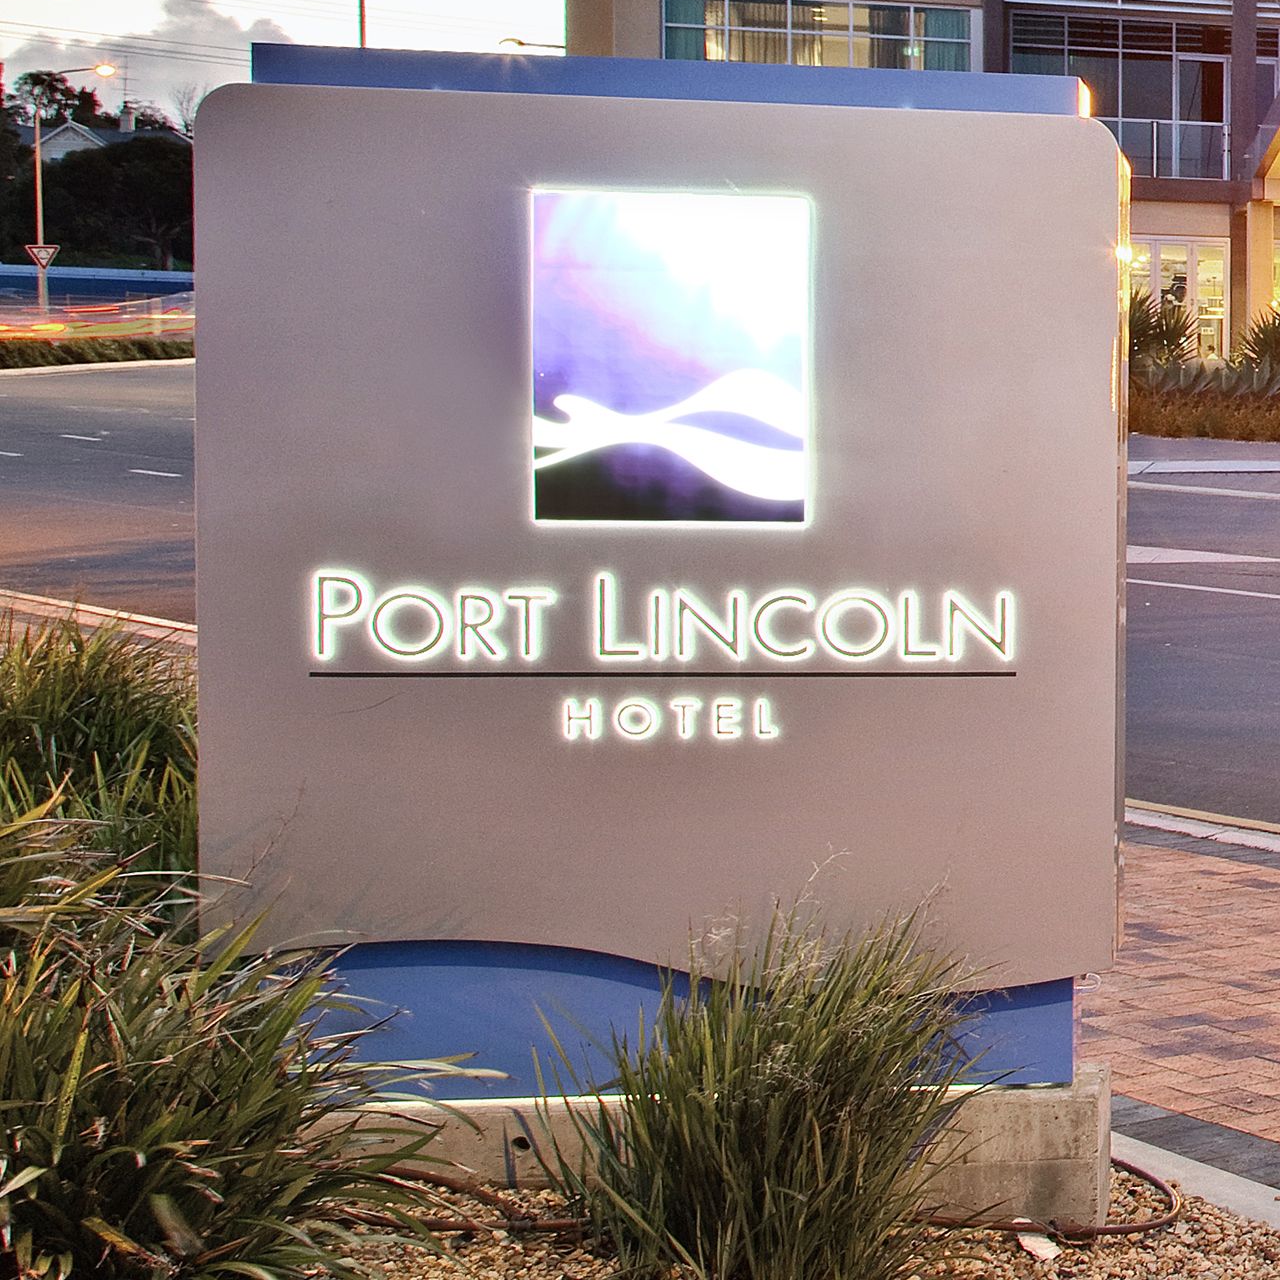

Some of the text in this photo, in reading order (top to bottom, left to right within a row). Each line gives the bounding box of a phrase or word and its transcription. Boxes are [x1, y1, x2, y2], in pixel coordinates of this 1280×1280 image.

[313, 572, 1010, 660] PORT LINCOLN
[564, 699, 776, 738] HOTEL
